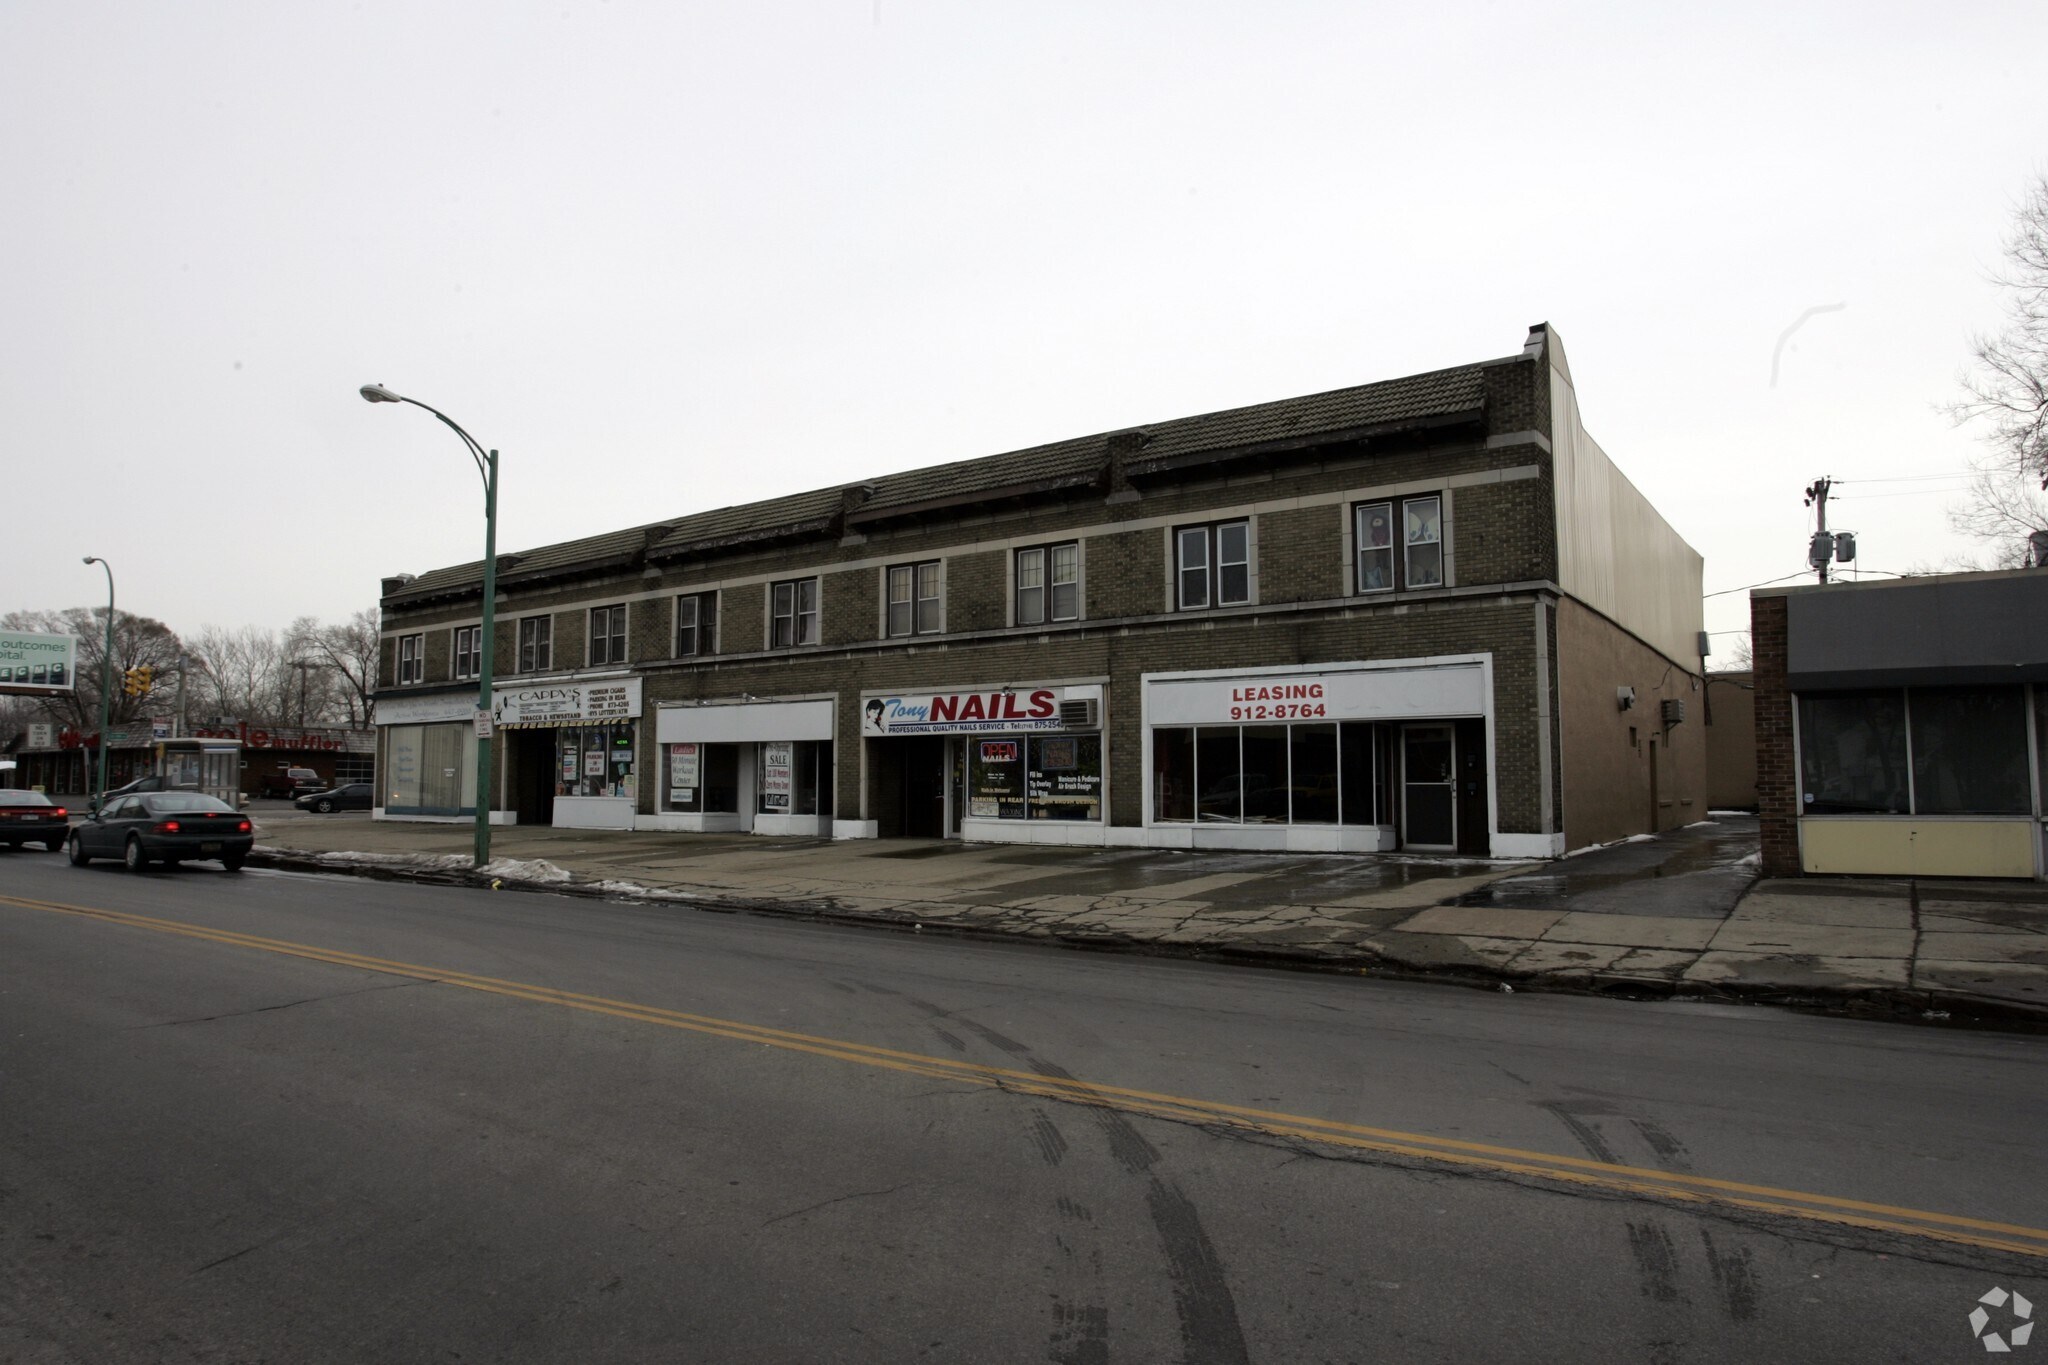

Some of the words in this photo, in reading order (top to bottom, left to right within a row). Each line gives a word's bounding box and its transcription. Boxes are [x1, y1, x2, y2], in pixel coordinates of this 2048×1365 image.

[1, 640, 66, 652] outcomes
[1, 664, 62, 677] ECMC
[519, 688, 581, 701] CAPPY'S
[1233, 684, 1323, 702] LEASING
[885, 698, 929, 721] Tony
[929, 690, 1055, 721] NAILS
[1230, 703, 1326, 720] 912-8764
[549, 712, 581, 720] NEWSSTAND
[888, 724, 931, 733] PROFESSIONAL
[933, 724, 957, 732] QUALITY
[959, 723, 977, 731] NAILS
[979, 722, 1005, 730] SERVICE
[1034, 720, 1064, 729] 875-254
[272, 735, 343, 750] muffler
[673, 746, 694, 754] Ladies
[982, 743, 1016, 760] OPEN
[679, 757, 697, 765] Minute
[770, 754, 787, 765] SALE
[673, 766, 694, 775] Workout
[673, 776, 691, 784] Center
[1077, 783, 1091, 791] Design
